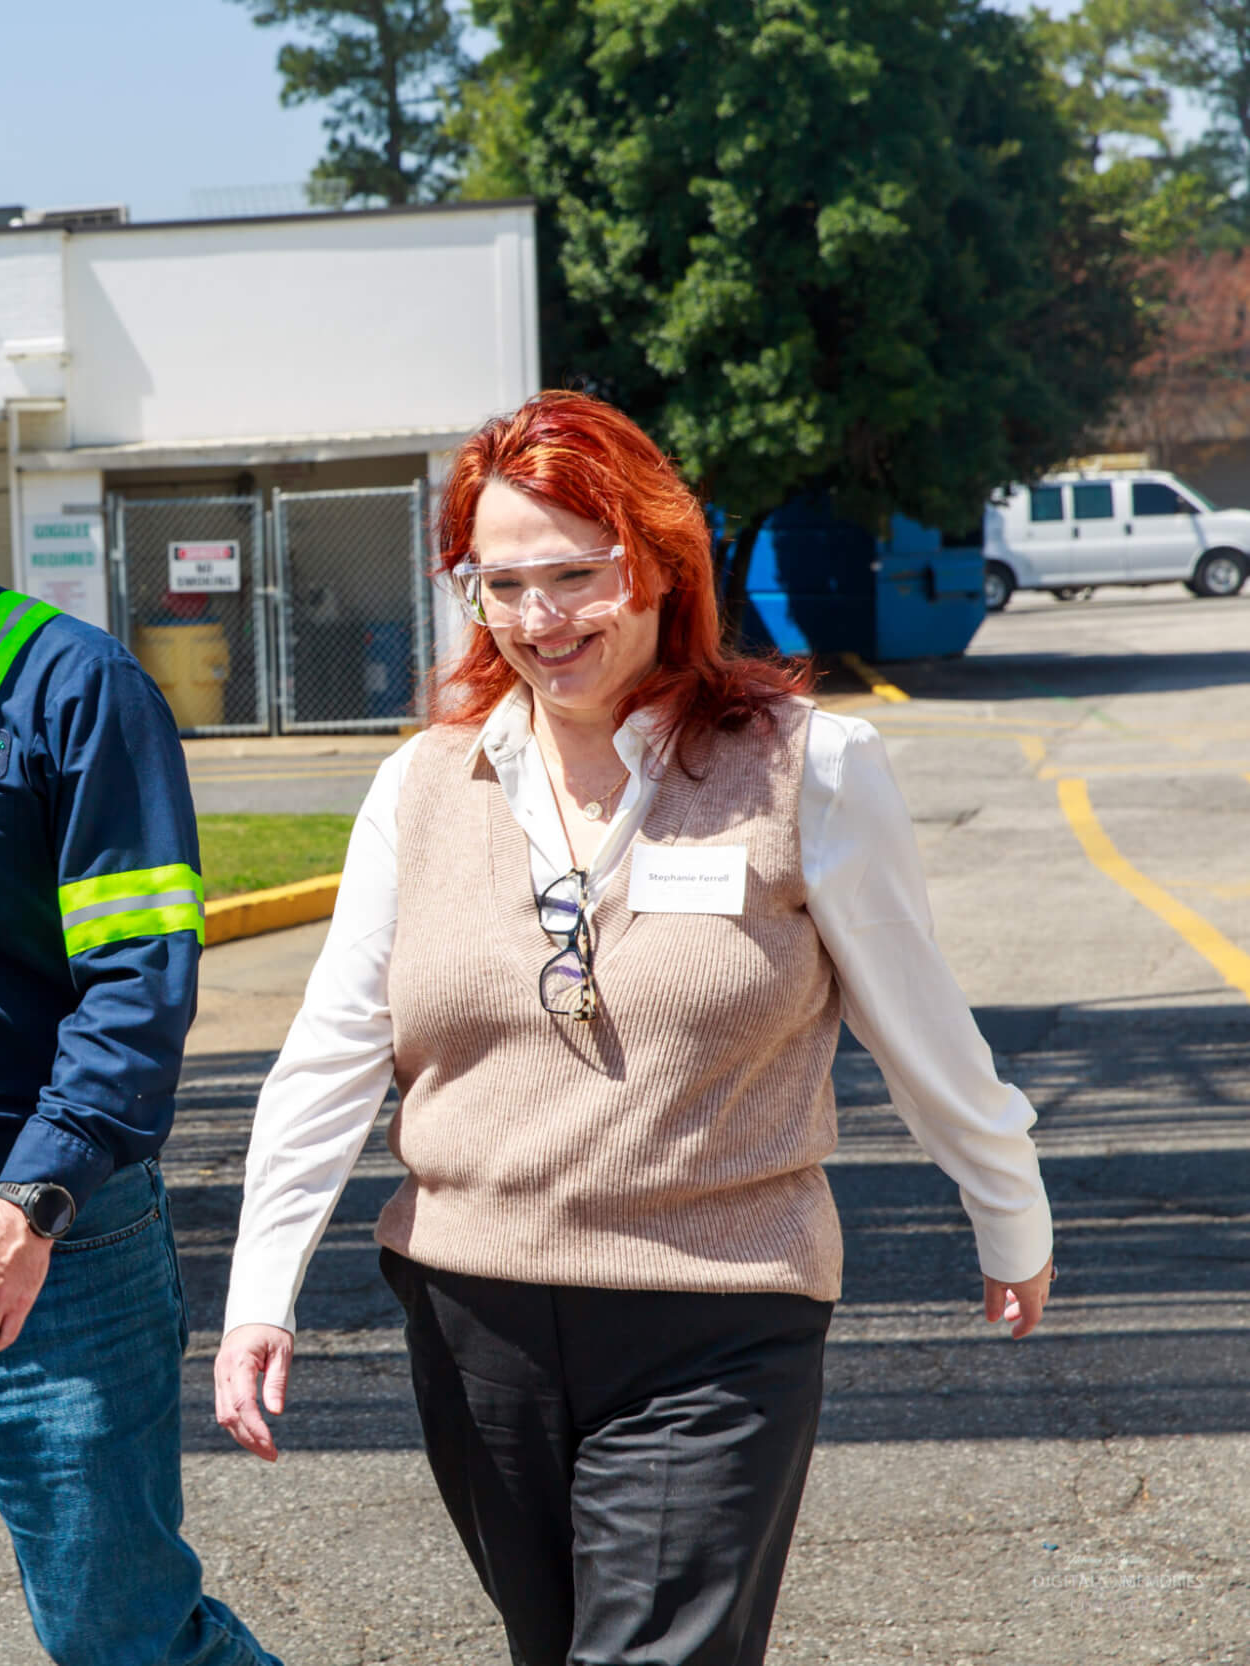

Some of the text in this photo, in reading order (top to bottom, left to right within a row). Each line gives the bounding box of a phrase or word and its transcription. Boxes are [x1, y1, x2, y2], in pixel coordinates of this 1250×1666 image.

[34, 523, 89, 539] GOGGLES
[31, 552, 94, 567] REQUIRED
[648, 872, 729, 882] Stephanie Ferrell
